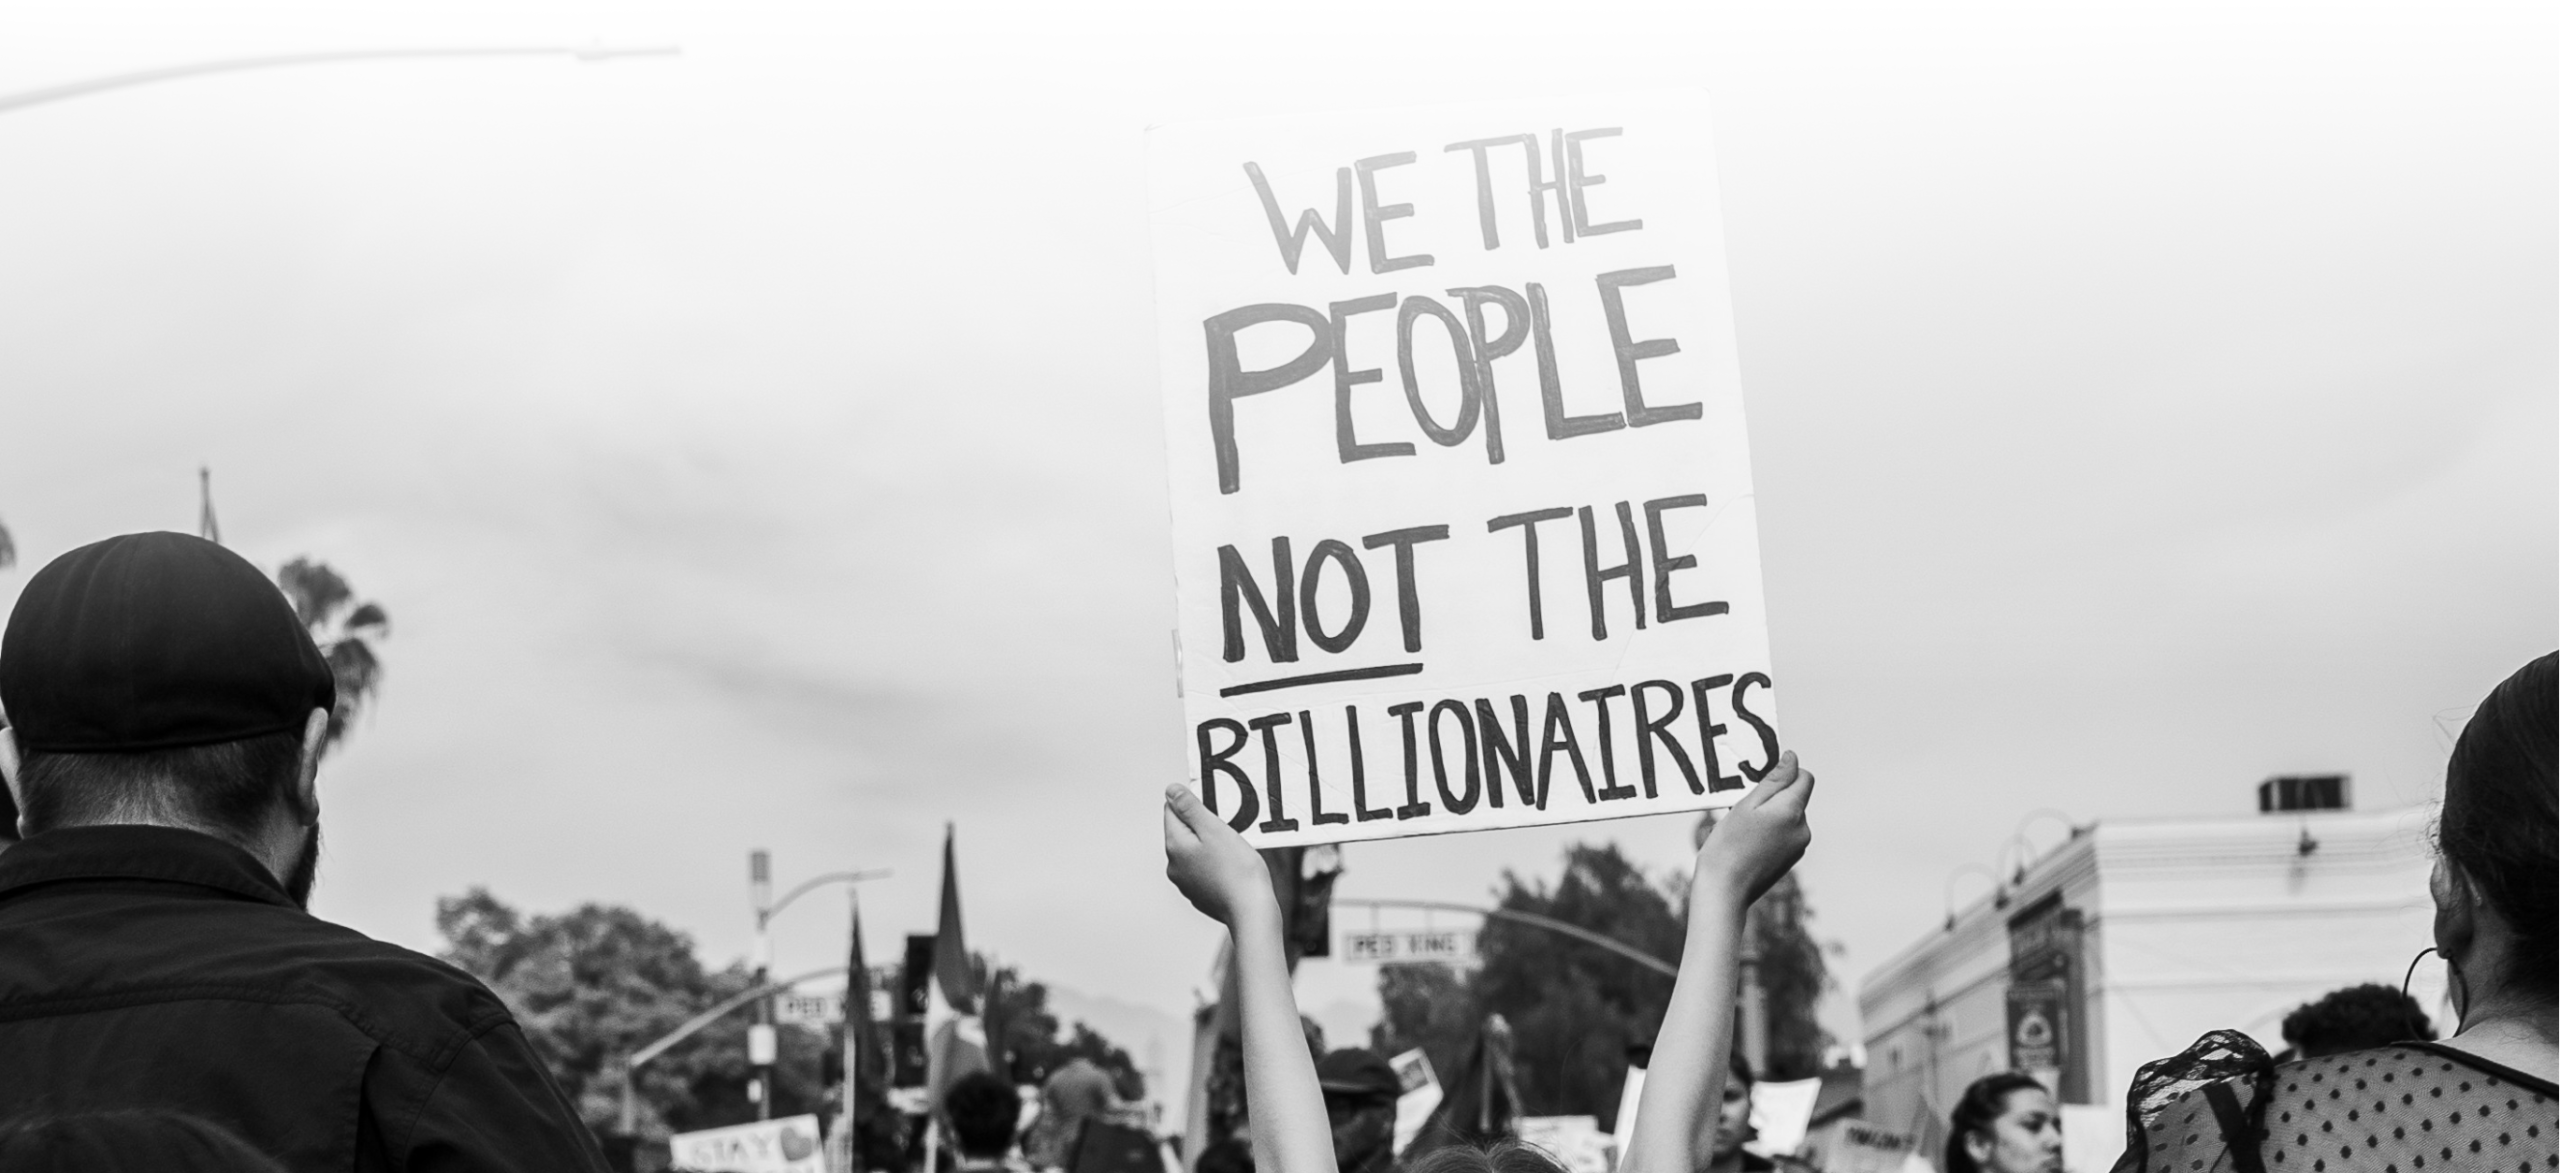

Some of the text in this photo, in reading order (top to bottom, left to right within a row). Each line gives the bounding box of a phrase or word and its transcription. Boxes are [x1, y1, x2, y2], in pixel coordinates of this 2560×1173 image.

[1243, 126, 1644, 276] WE THE
[1202, 264, 1704, 496] PEOPLE
[1217, 493, 1730, 664] NOT THE
[1196, 671, 1781, 835] BILLIONAIRES
